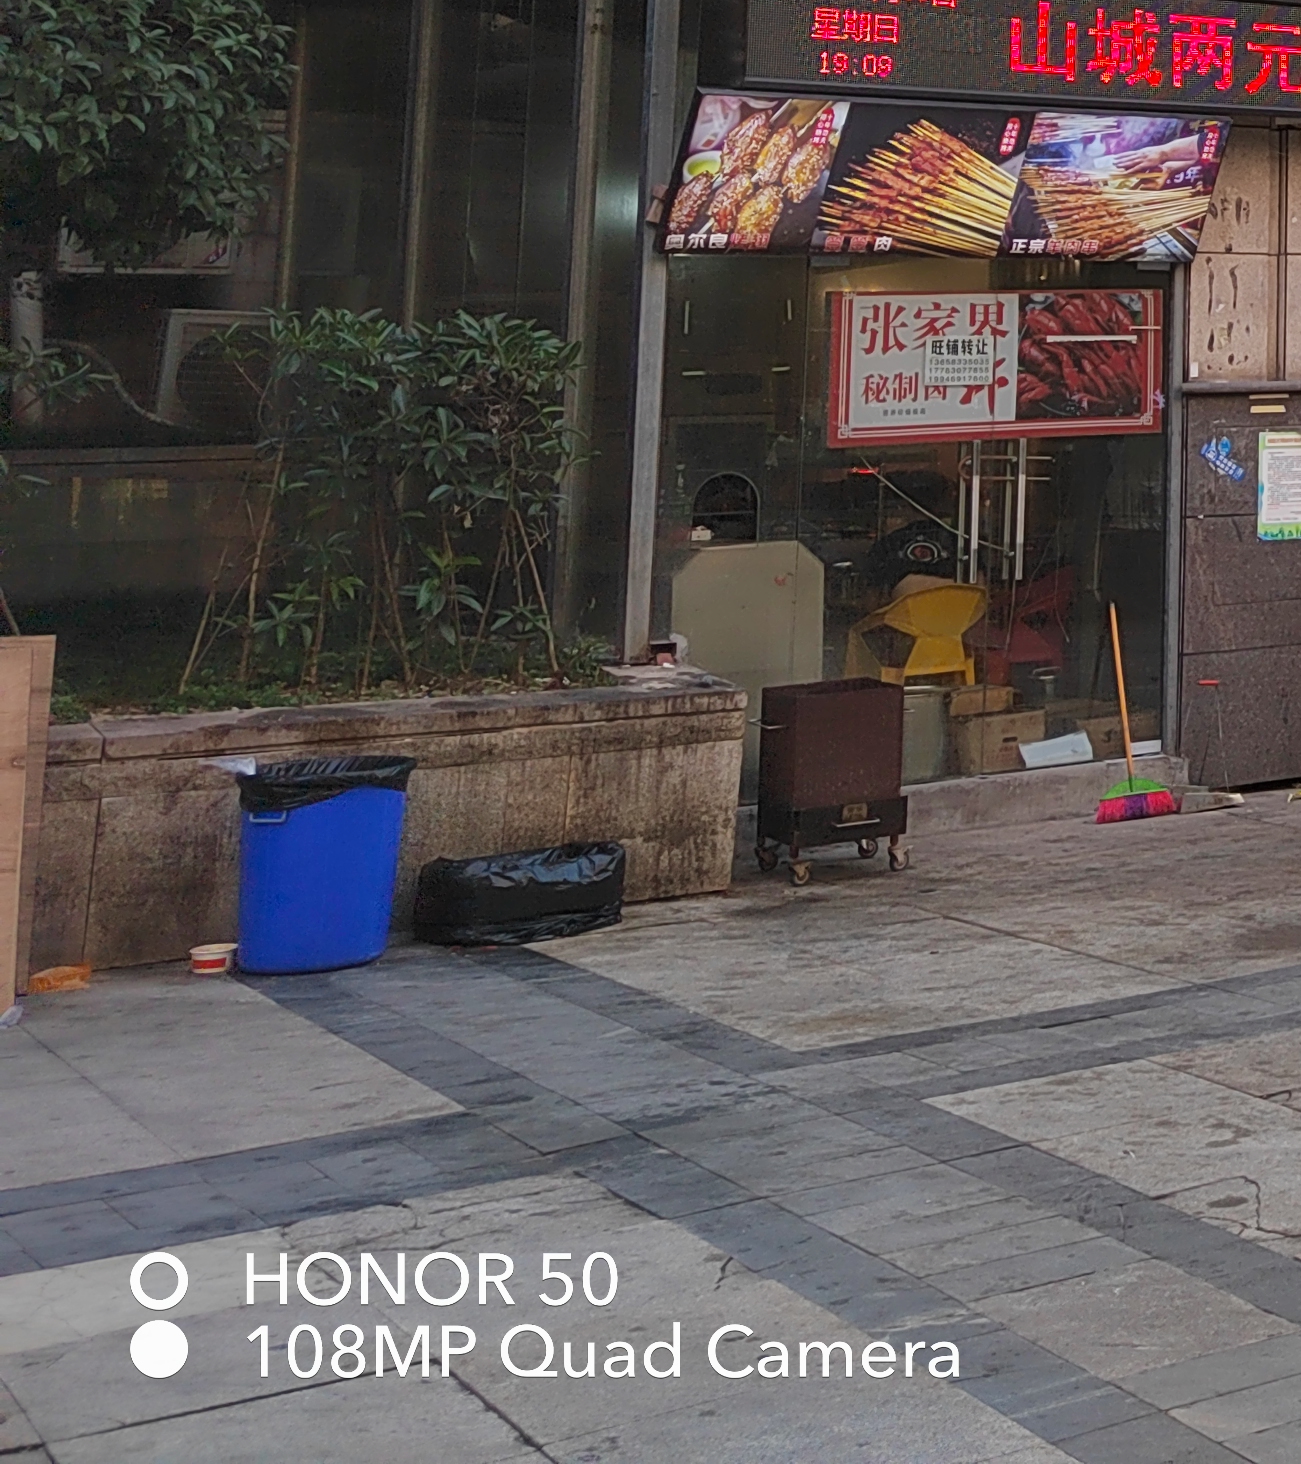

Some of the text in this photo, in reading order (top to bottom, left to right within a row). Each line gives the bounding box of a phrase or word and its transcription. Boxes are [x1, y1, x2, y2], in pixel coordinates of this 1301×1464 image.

[810, 7, 900, 45] 星期日
[1009, 238, 1099, 254] 正宗羊肉串
[859, 301, 1010, 355] 张家界
[931, 338, 988, 356] 旺铺转让
